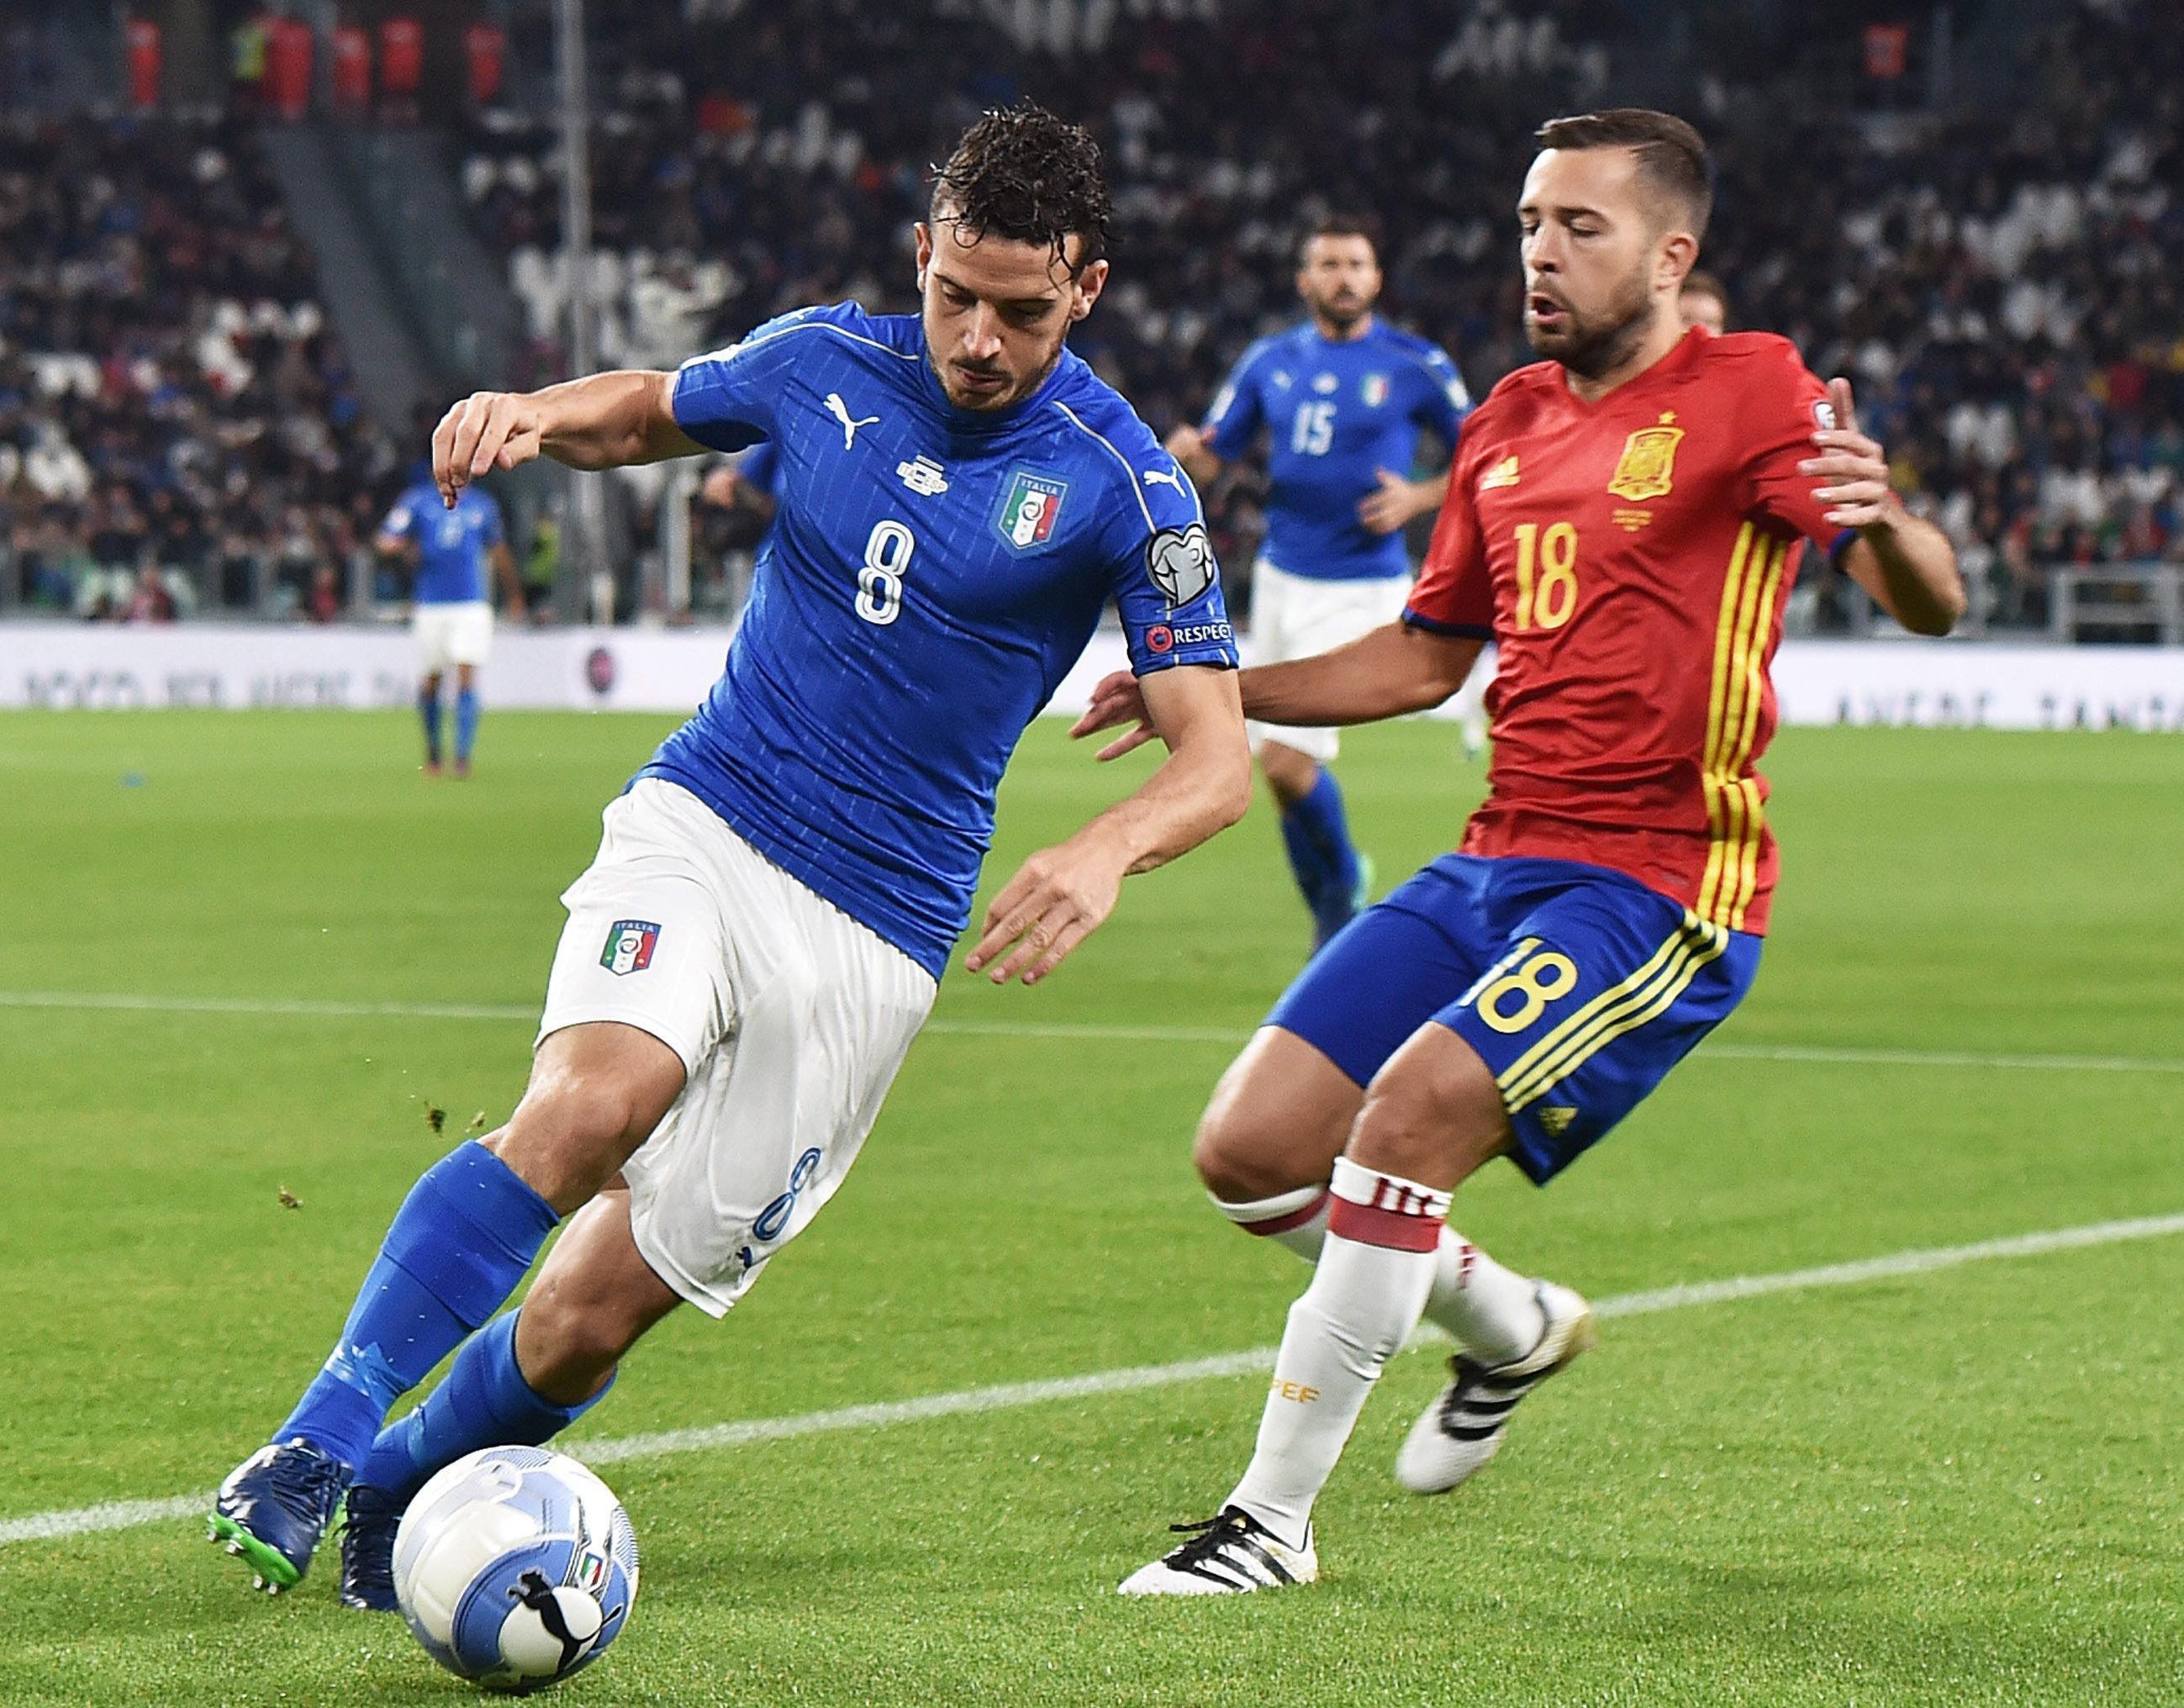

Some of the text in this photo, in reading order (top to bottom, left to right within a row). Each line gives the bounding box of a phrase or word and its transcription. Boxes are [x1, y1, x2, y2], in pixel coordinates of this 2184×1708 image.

[1293, 401, 1337, 456] 15
[1020, 478, 1059, 495] ITALIA
[855, 519, 915, 625] 8
[1514, 521, 1578, 631] 18
[1174, 624, 1232, 644] RESPECT
[614, 922, 655, 932] ITALIA
[1459, 937, 1579, 1034] 18
[752, 1147, 821, 1241] 8
